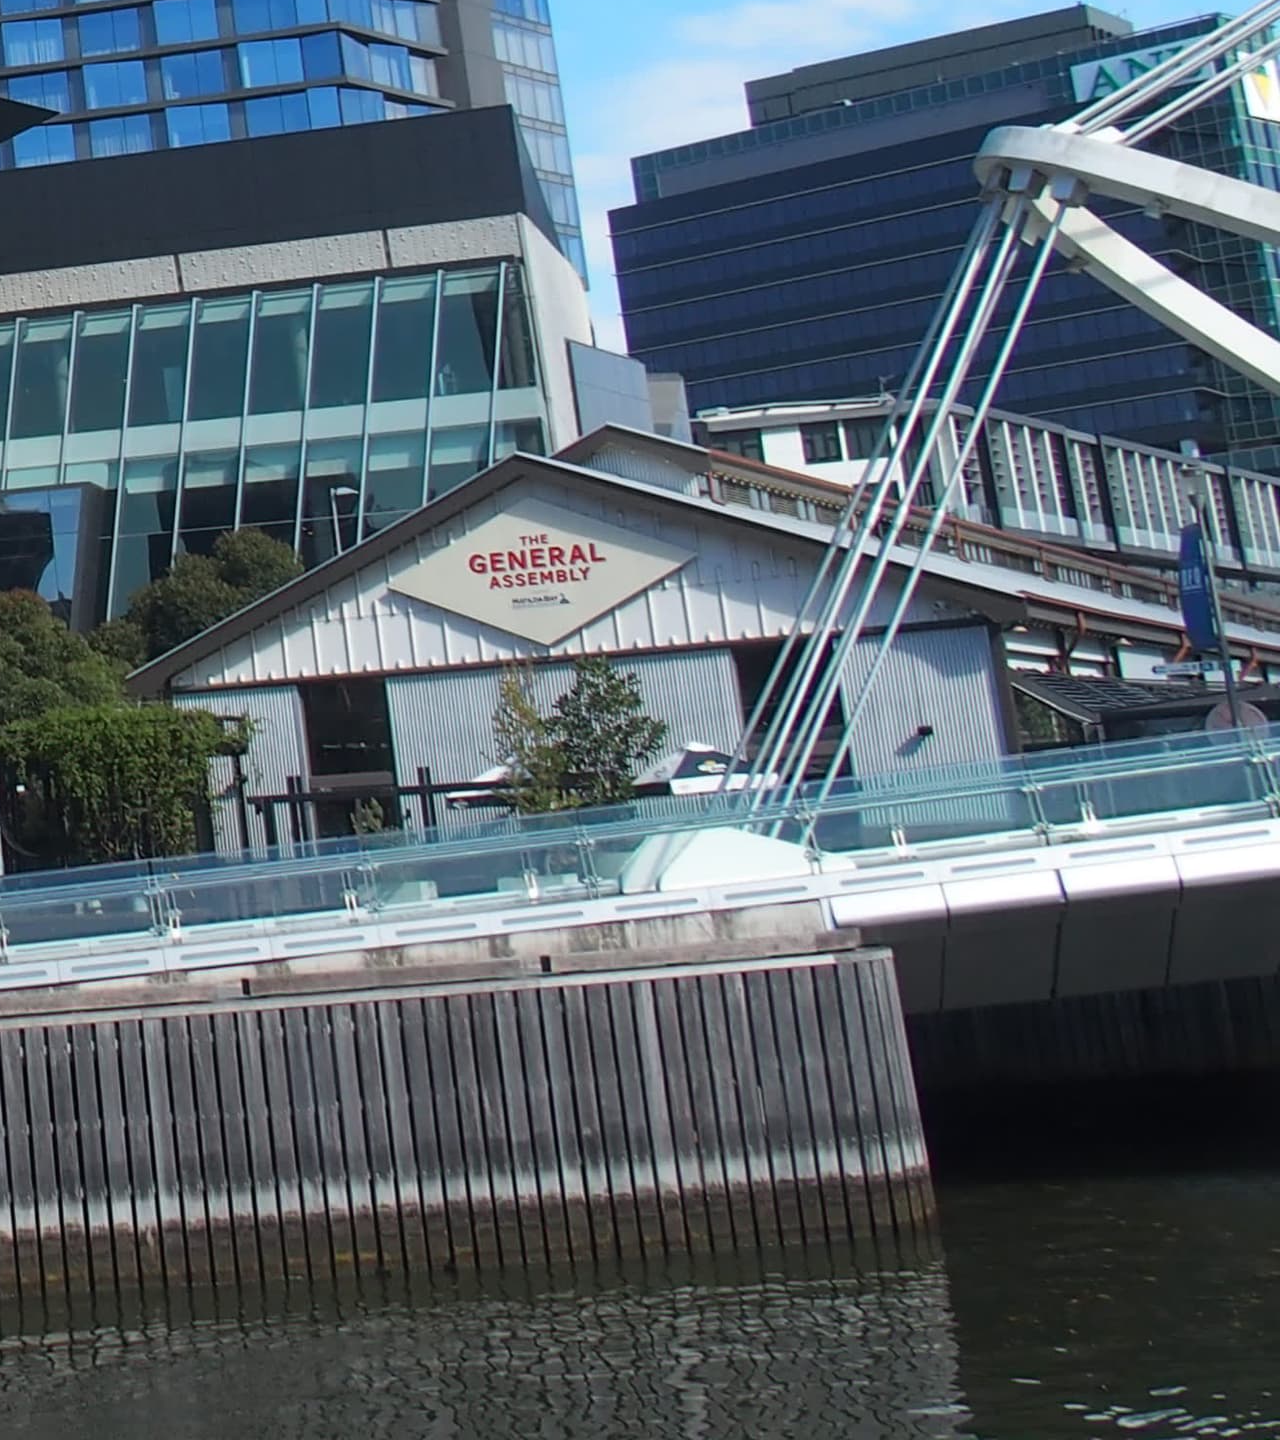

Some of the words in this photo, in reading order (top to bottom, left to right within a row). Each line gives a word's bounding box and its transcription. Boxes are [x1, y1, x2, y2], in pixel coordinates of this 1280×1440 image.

[519, 534, 549, 546] THE
[469, 542, 607, 574] GENERAL
[490, 566, 591, 589] ASSEMBLY
